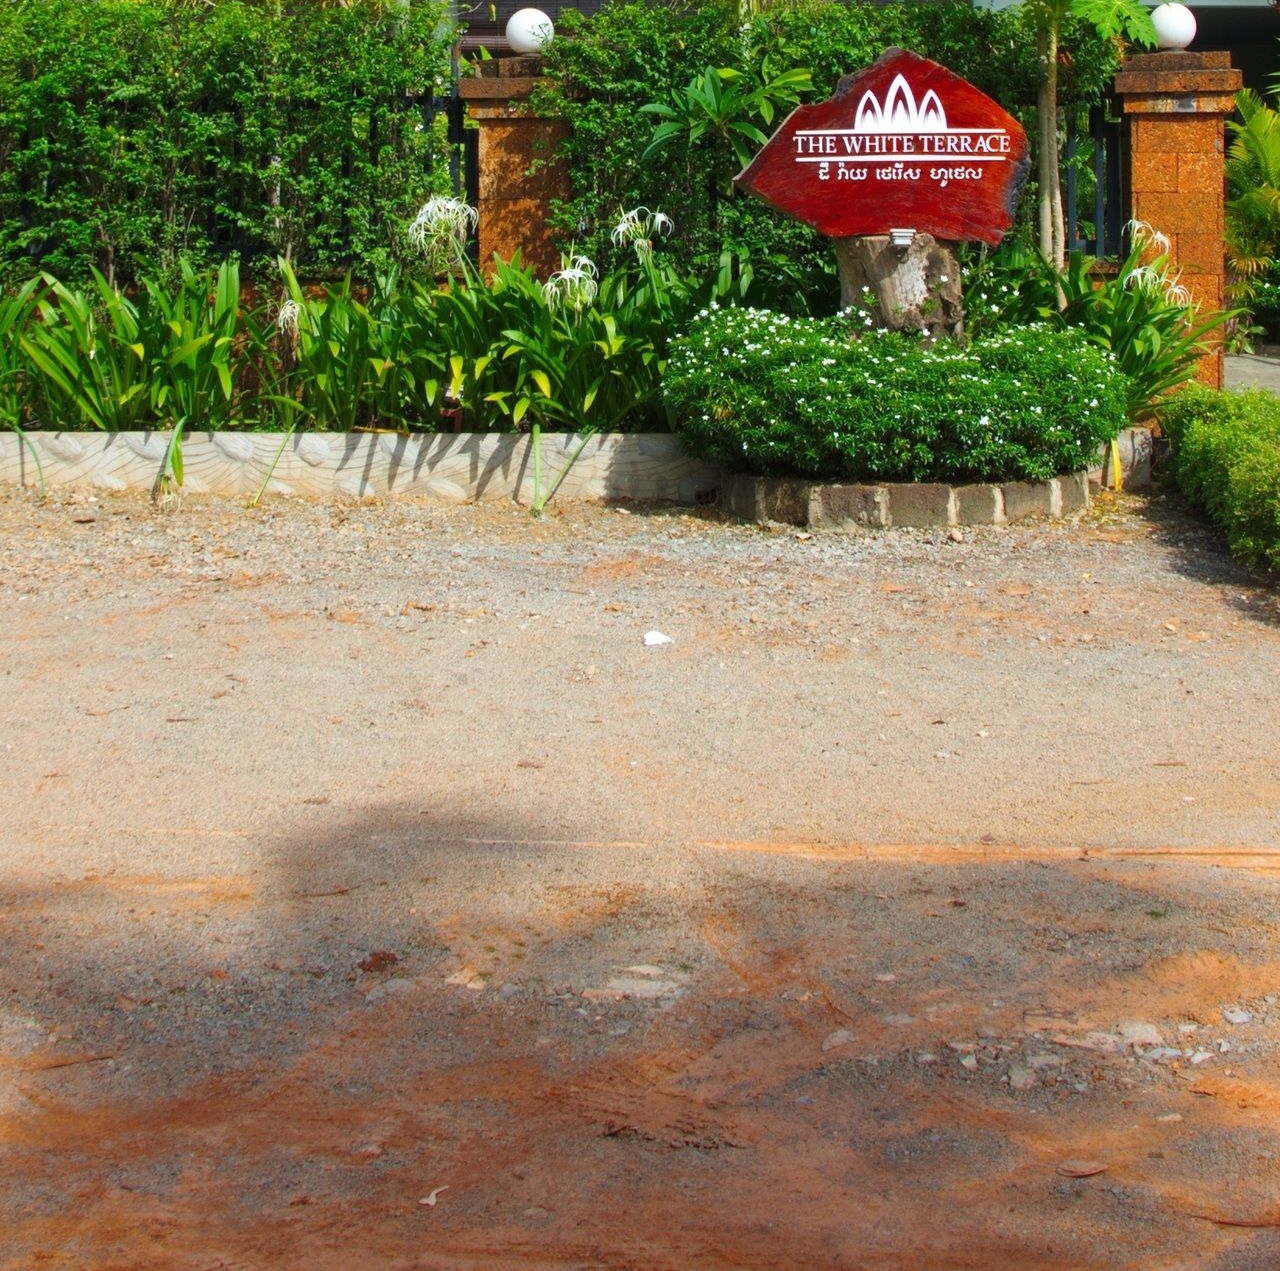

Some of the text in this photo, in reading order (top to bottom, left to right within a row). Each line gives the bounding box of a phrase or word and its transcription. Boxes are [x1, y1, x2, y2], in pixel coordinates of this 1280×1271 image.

[792, 135, 1011, 154] THE WHITE TERRACE
